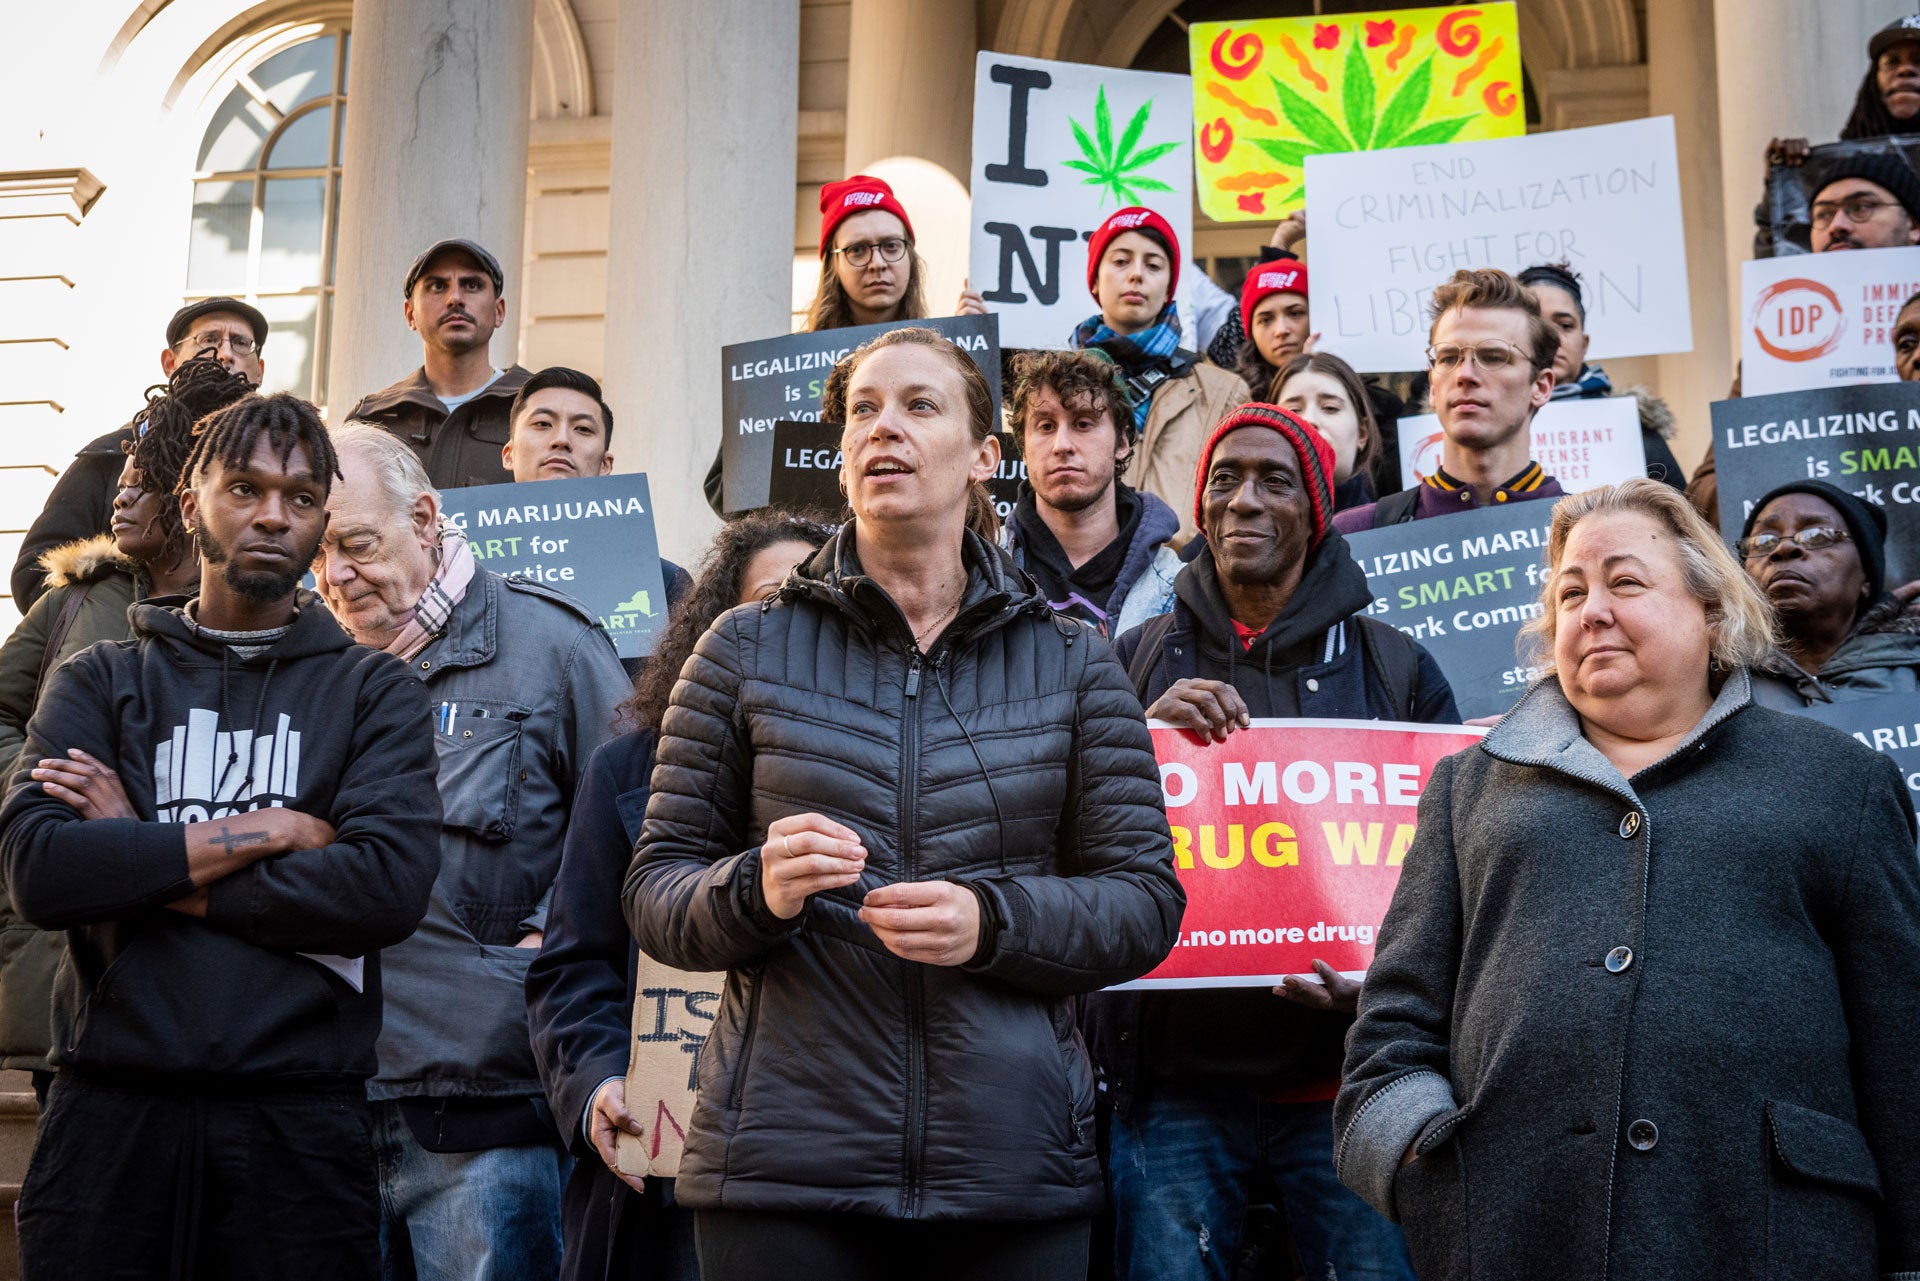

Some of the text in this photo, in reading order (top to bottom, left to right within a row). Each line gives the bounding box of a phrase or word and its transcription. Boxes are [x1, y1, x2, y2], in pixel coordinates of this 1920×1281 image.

[985, 64, 1052, 187] I
[1411, 156, 1476, 185] END
[1335, 160, 1656, 229] CRIMINALIZATION
[982, 221, 1095, 306] N
[1389, 229, 1585, 273] FIGHT FOR
[1777, 304, 1823, 337] IDP
[784, 384, 802, 403] is
[1530, 427, 1613, 446] MIGRANT
[1726, 410, 1899, 449] LEGALIZING
[1806, 445, 1920, 479] is SMA
[477, 496, 645, 528] MARIJUANA
[469, 535, 569, 561] ART for
[1359, 525, 1552, 579] LIZING MARIJ
[1397, 566, 1516, 610] SMART
[1160, 760, 1422, 808] O MORE
[1170, 821, 1300, 870] RUG
